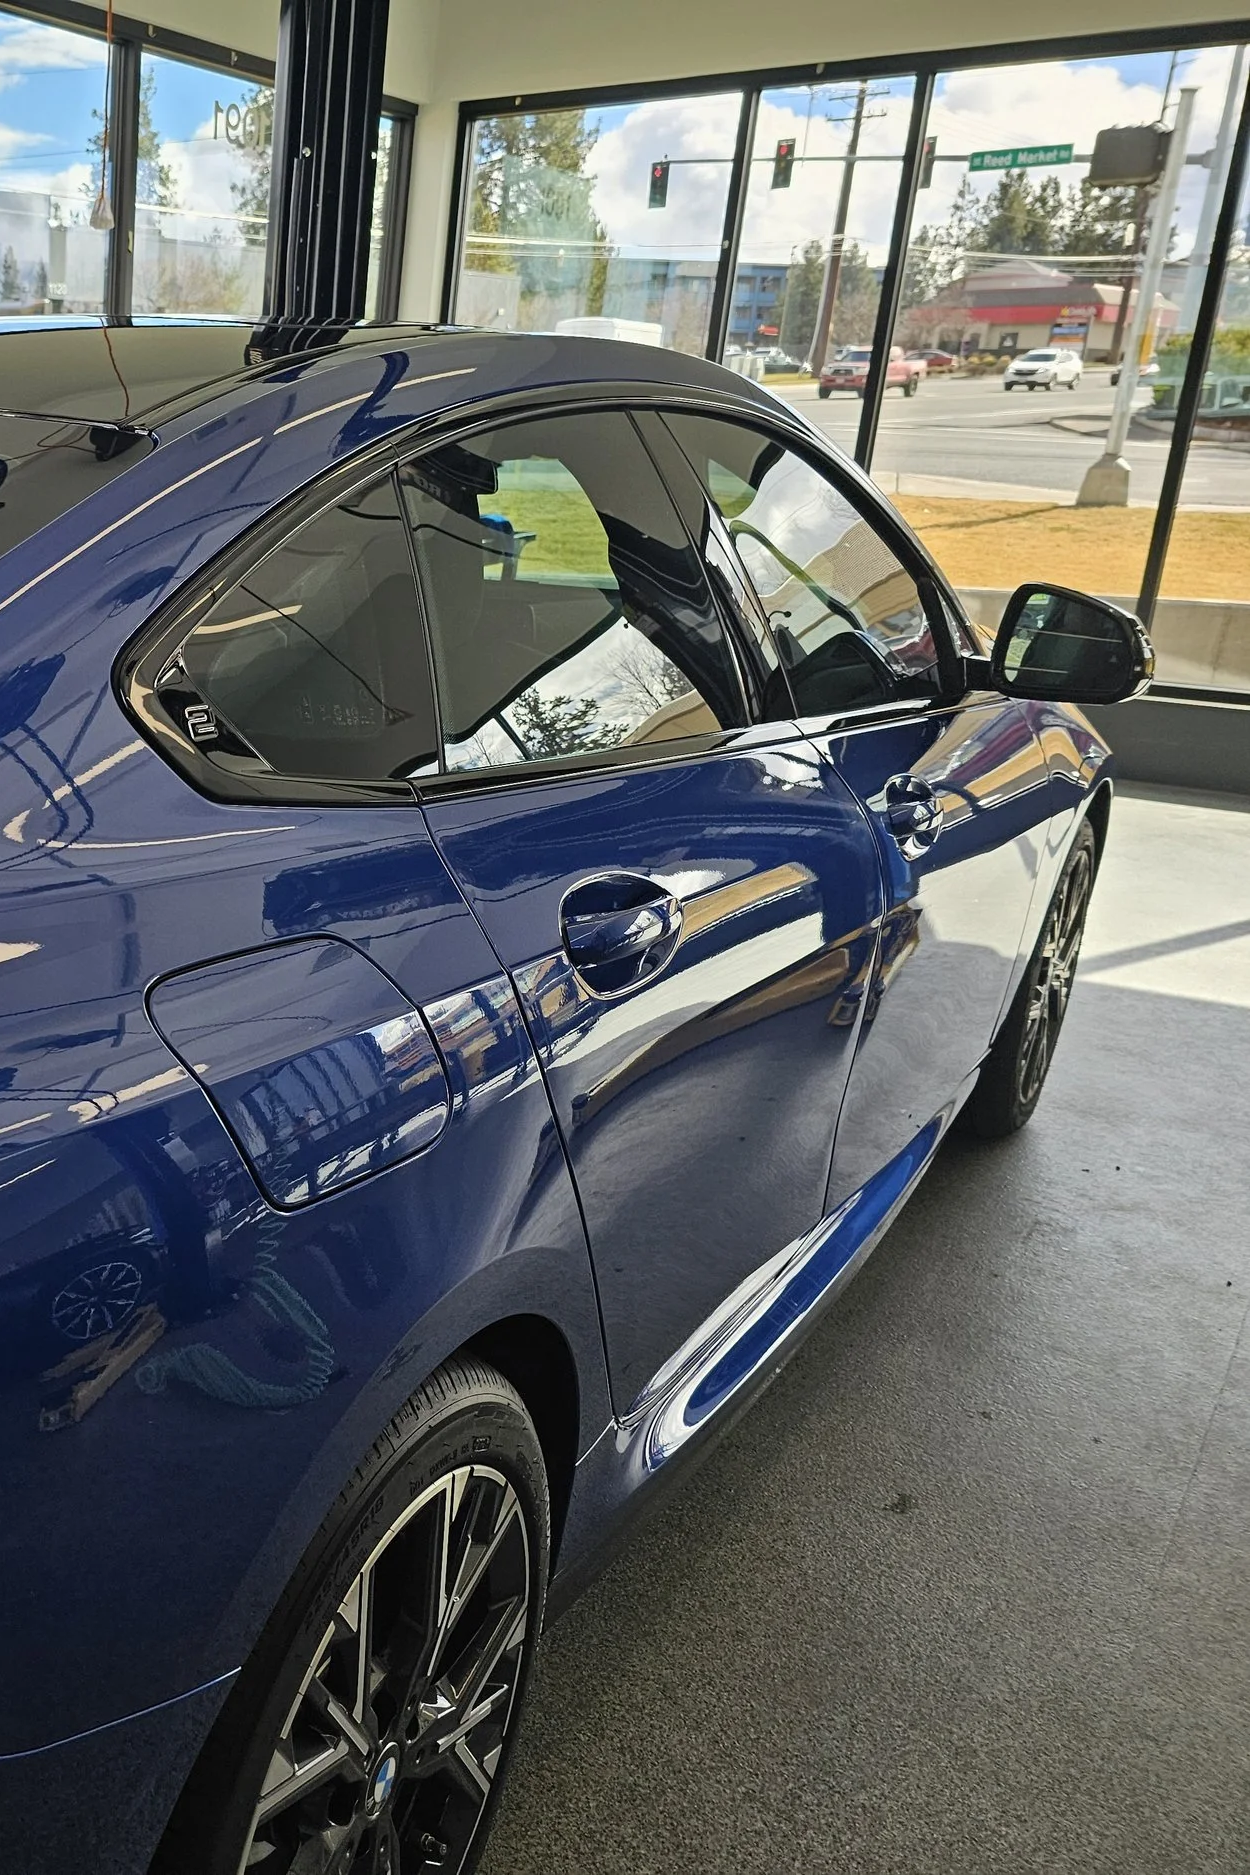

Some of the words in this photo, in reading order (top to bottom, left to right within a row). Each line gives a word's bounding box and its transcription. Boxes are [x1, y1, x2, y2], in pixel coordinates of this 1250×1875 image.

[983, 153, 1012, 168] Reed
[1017, 149, 1058, 164] Market
[185, 704, 219, 742] 2
